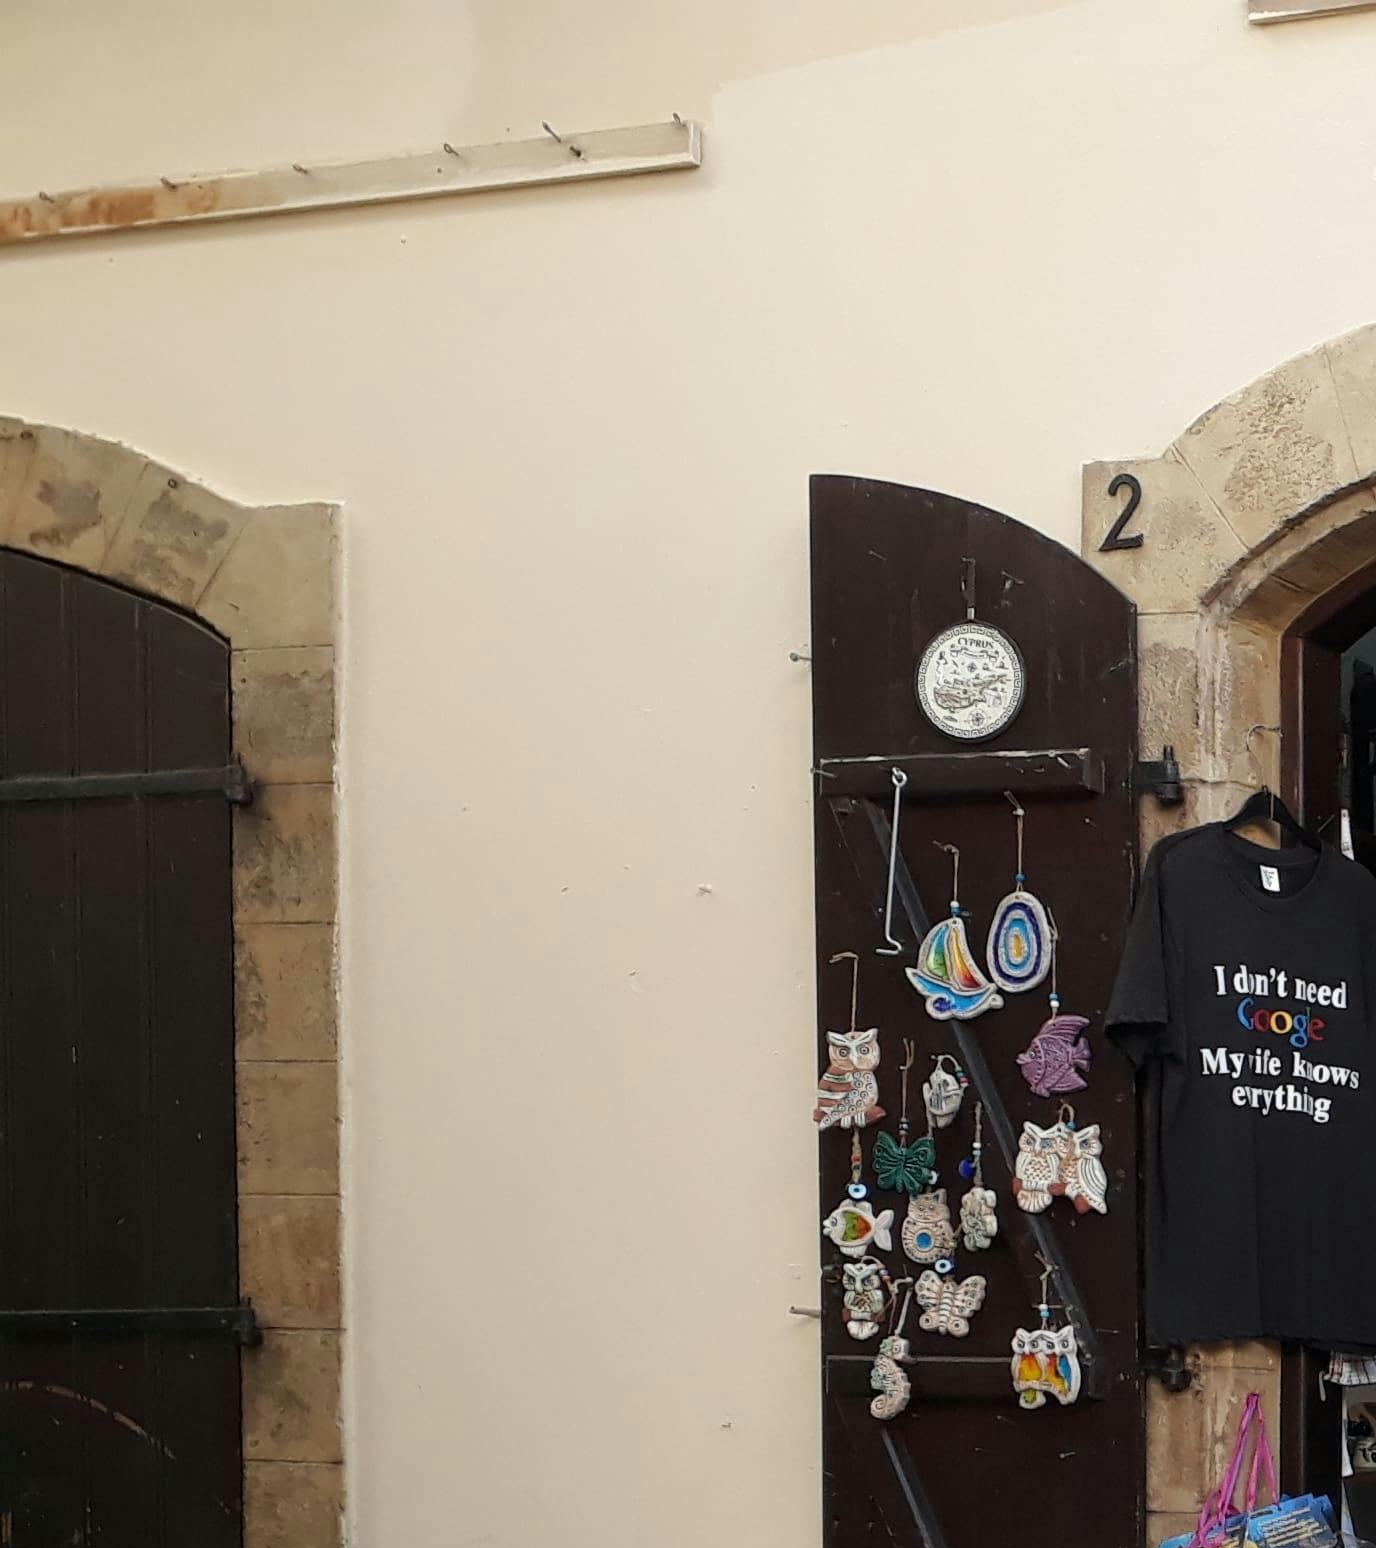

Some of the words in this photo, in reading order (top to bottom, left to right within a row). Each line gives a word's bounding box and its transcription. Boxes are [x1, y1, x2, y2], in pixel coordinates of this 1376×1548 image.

[1097, 472, 1146, 553] 2
[957, 637, 995, 649] CYPRUS
[1213, 964, 1227, 996] I
[1294, 977, 1348, 1009] need
[1236, 996, 1326, 1049] Google
[1200, 1047, 1246, 1079] My
[1292, 1051, 1360, 1090] knows
